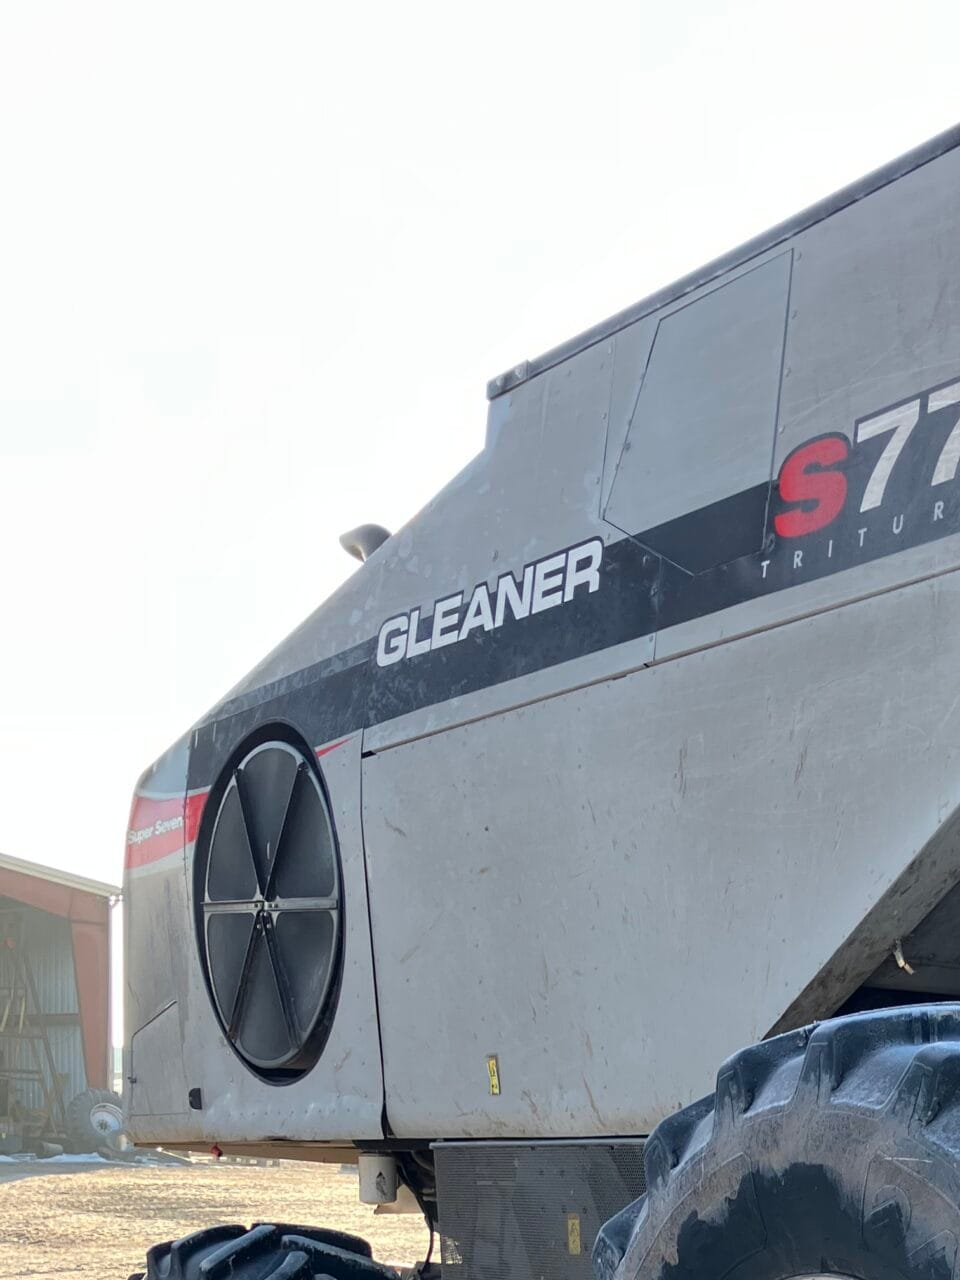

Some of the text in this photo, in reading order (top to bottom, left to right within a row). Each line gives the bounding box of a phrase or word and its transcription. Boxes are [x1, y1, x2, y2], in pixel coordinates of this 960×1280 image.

[376, 537, 604, 668] GLEANER
[127, 816, 182, 844] Super Seven
